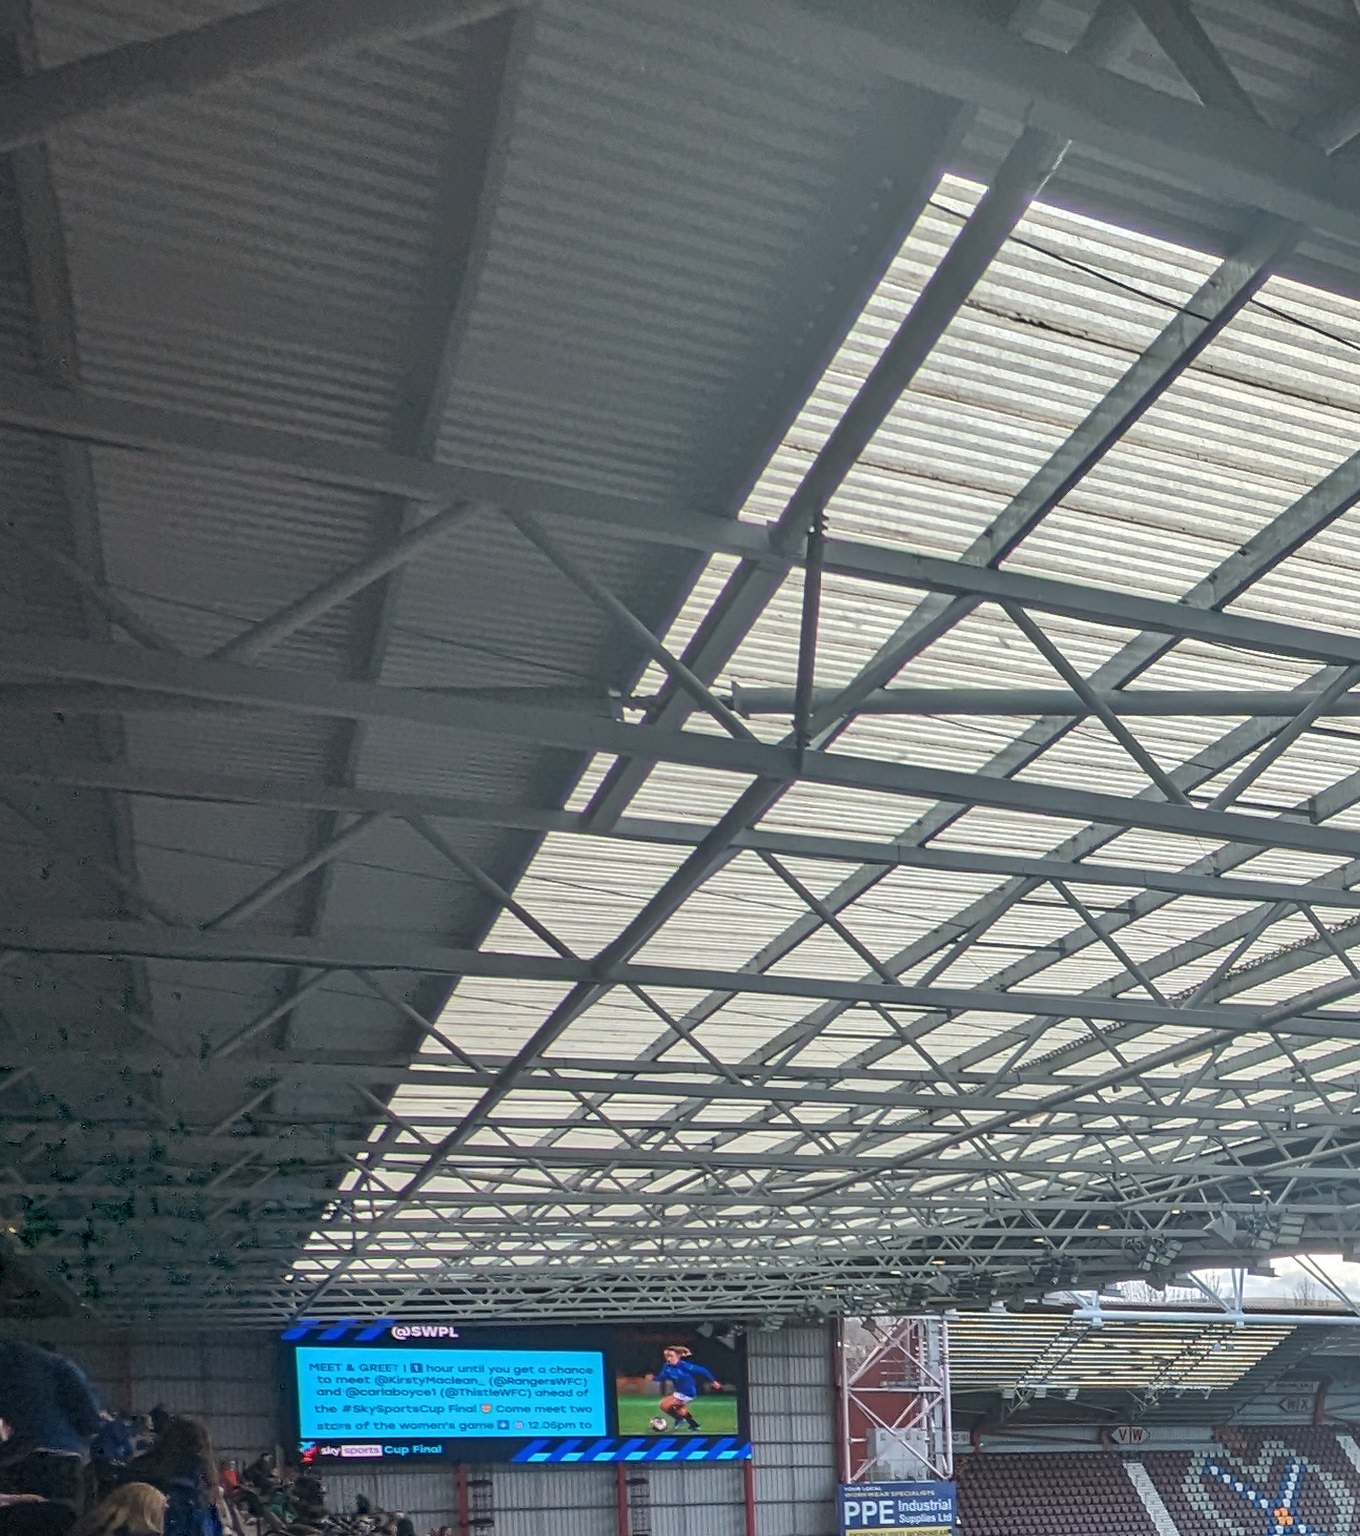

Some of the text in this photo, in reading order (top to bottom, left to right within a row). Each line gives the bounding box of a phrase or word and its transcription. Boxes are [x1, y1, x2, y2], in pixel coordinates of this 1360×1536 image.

[391, 1326, 459, 1340] @SWPL
[309, 1363, 342, 1373] MEET
[345, 1363, 355, 1373] &
[359, 1364, 399, 1373] GREET
[426, 1363, 455, 1374] hour
[457, 1365, 485, 1374] until
[488, 1367, 511, 1376] you
[513, 1366, 534, 1376] get
[550, 1366, 594, 1375] chance
[317, 1376, 332, 1385] to
[335, 1376, 371, 1385] meet
[316, 1387, 341, 1397] and
[535, 1388, 573, 1397] ahead
[576, 1388, 588, 1397] of
[314, 1404, 593, 1416] the #SkySportsCup Final Come meet two
[317, 1421, 351, 1431] stars
[355, 1421, 369, 1430] of
[373, 1421, 396, 1431] the
[400, 1421, 456, 1430] women's
[459, 1423, 494, 1431] game
[579, 1421, 593, 1430] to
[1119, 1429, 1143, 1441] V W
[320, 1444, 442, 1456] sky sports Cup Final
[844, 1499, 952, 1525] PPE Industrial
[899, 1513, 952, 1525] Supplies Ltd
